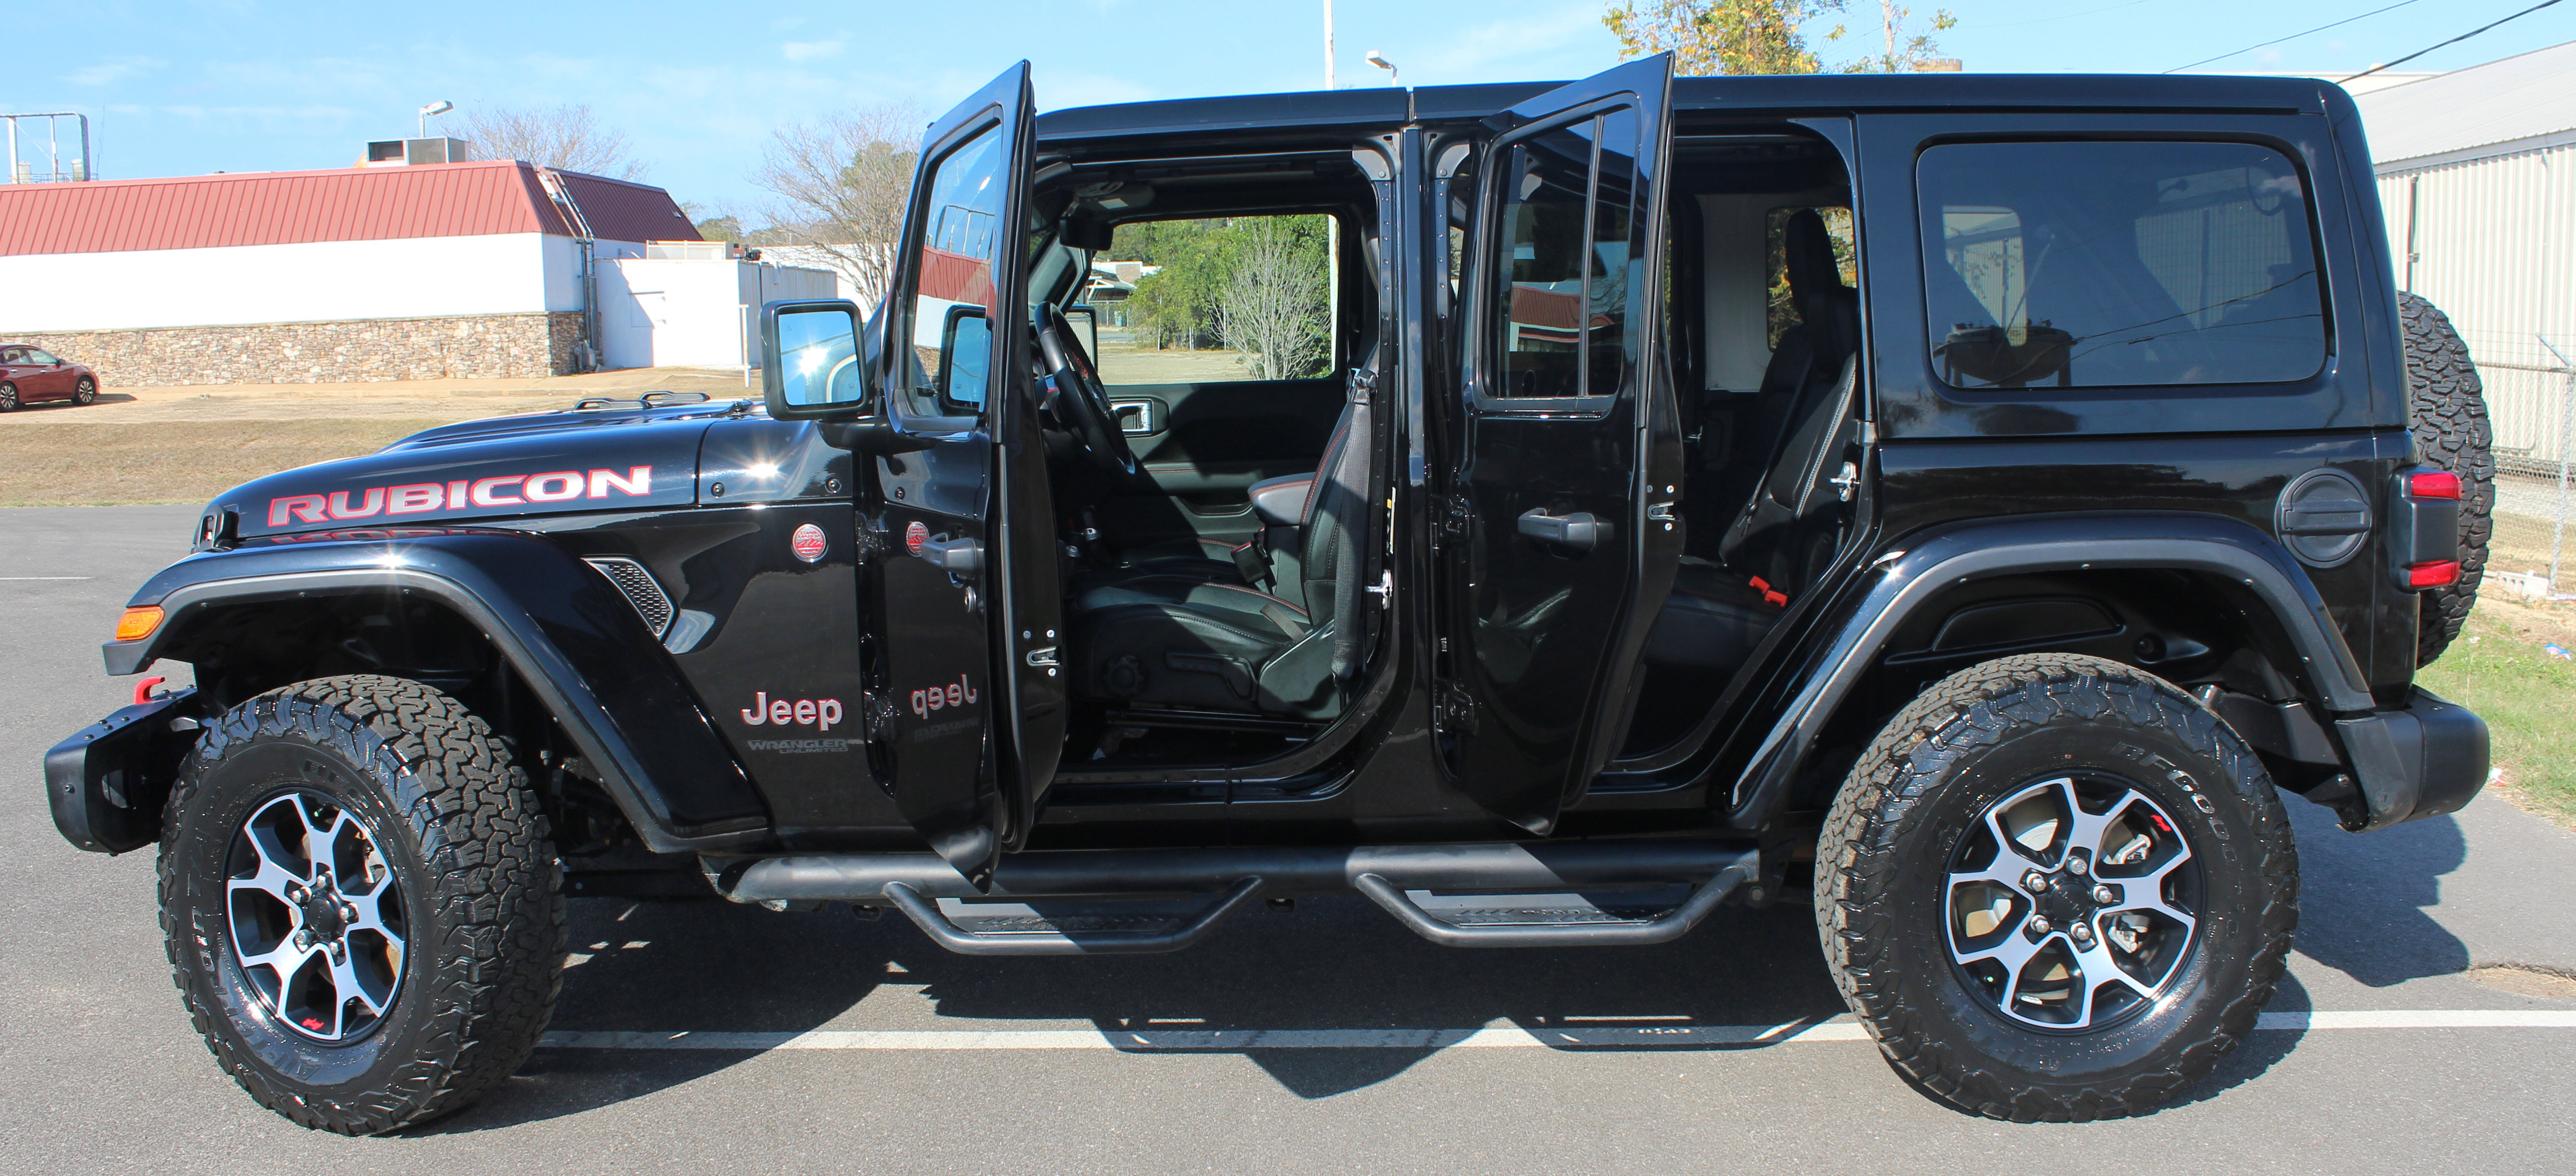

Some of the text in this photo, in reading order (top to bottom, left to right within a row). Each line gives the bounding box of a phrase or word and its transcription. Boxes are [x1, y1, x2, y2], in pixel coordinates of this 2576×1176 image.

[268, 465, 652, 527] RUBICON
[741, 691, 843, 731] Jeep
[747, 739, 847, 750] WRANGLER
